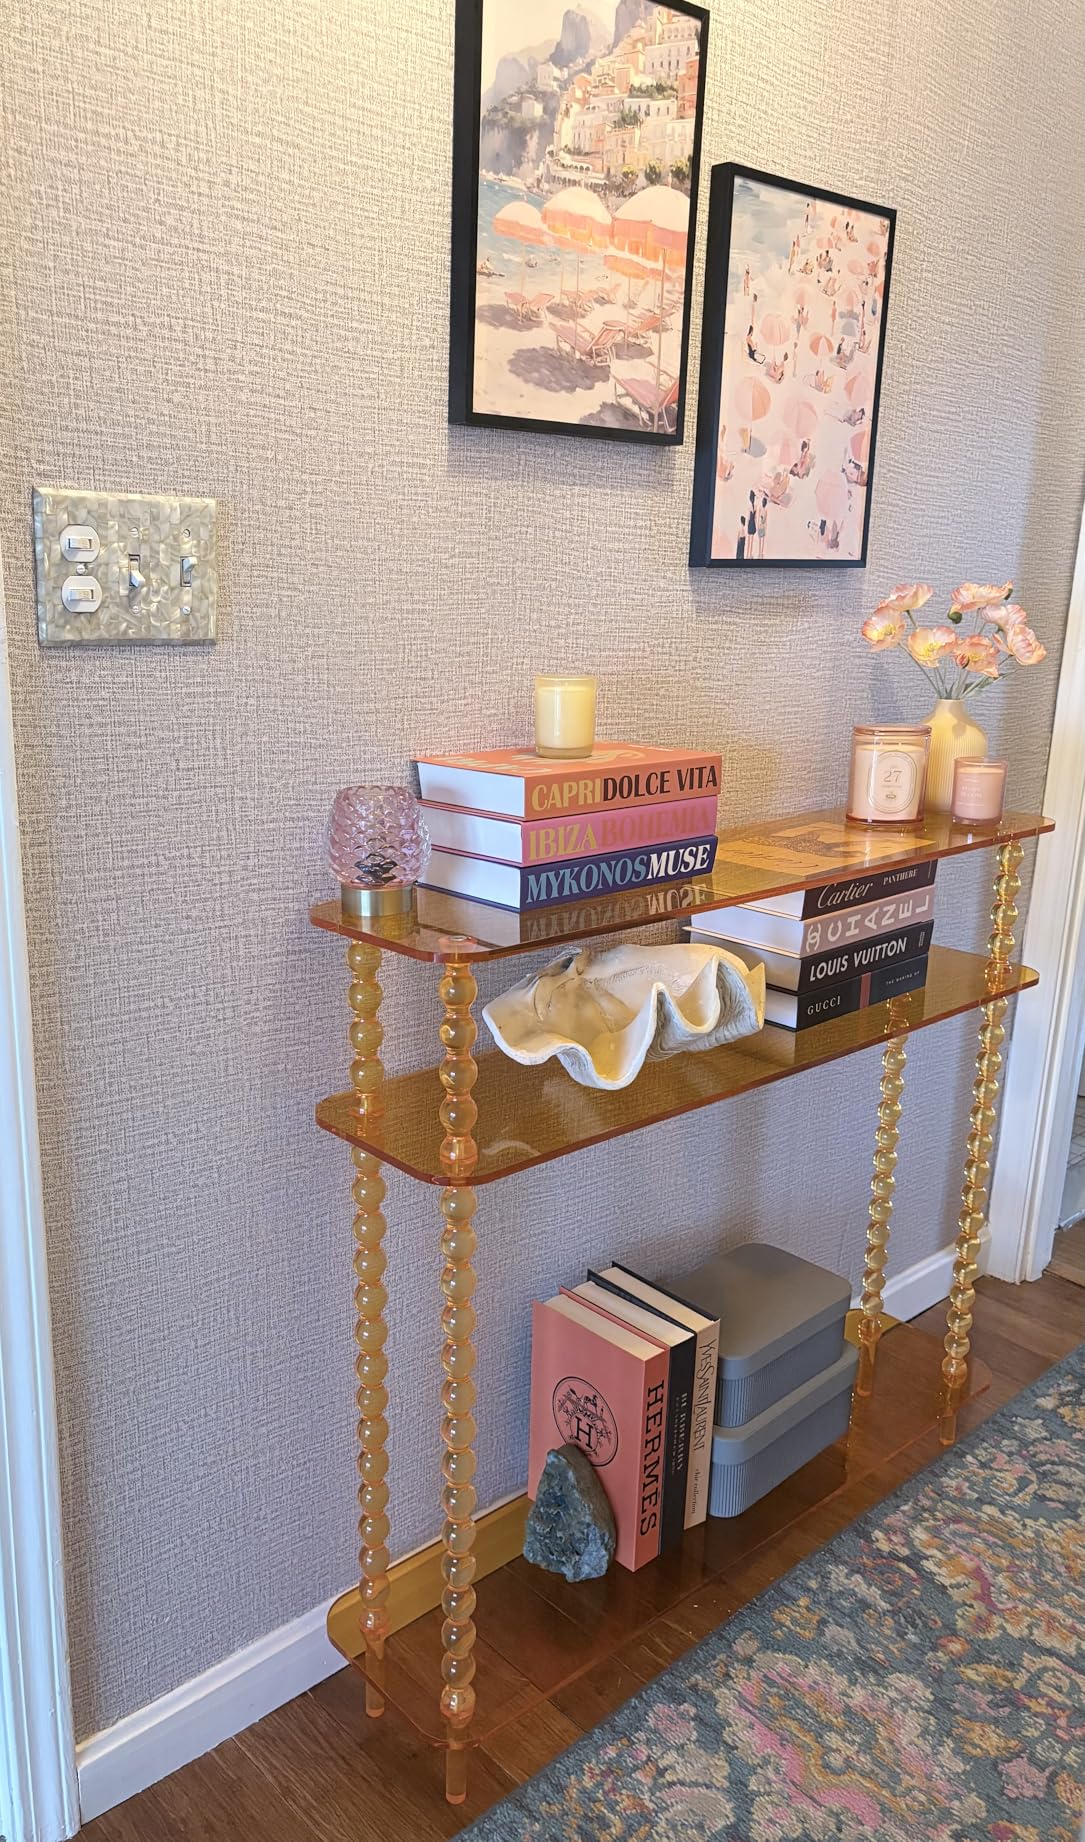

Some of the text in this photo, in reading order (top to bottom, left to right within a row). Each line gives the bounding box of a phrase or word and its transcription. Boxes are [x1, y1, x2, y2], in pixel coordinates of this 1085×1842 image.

[531, 765, 718, 812] CAPRI DOLCE VITA
[882, 769, 904, 784] 27
[528, 805, 711, 861] IBIZA BOHEMIA
[526, 855, 648, 904] MYKONOS
[646, 844, 711, 879] MUSE
[817, 882, 874, 909] Cartier
[828, 895, 930, 942] CHANEL
[809, 955, 849, 982] LOUIS
[853, 937, 908, 969] VUITTON
[807, 995, 842, 1016] GUCCI
